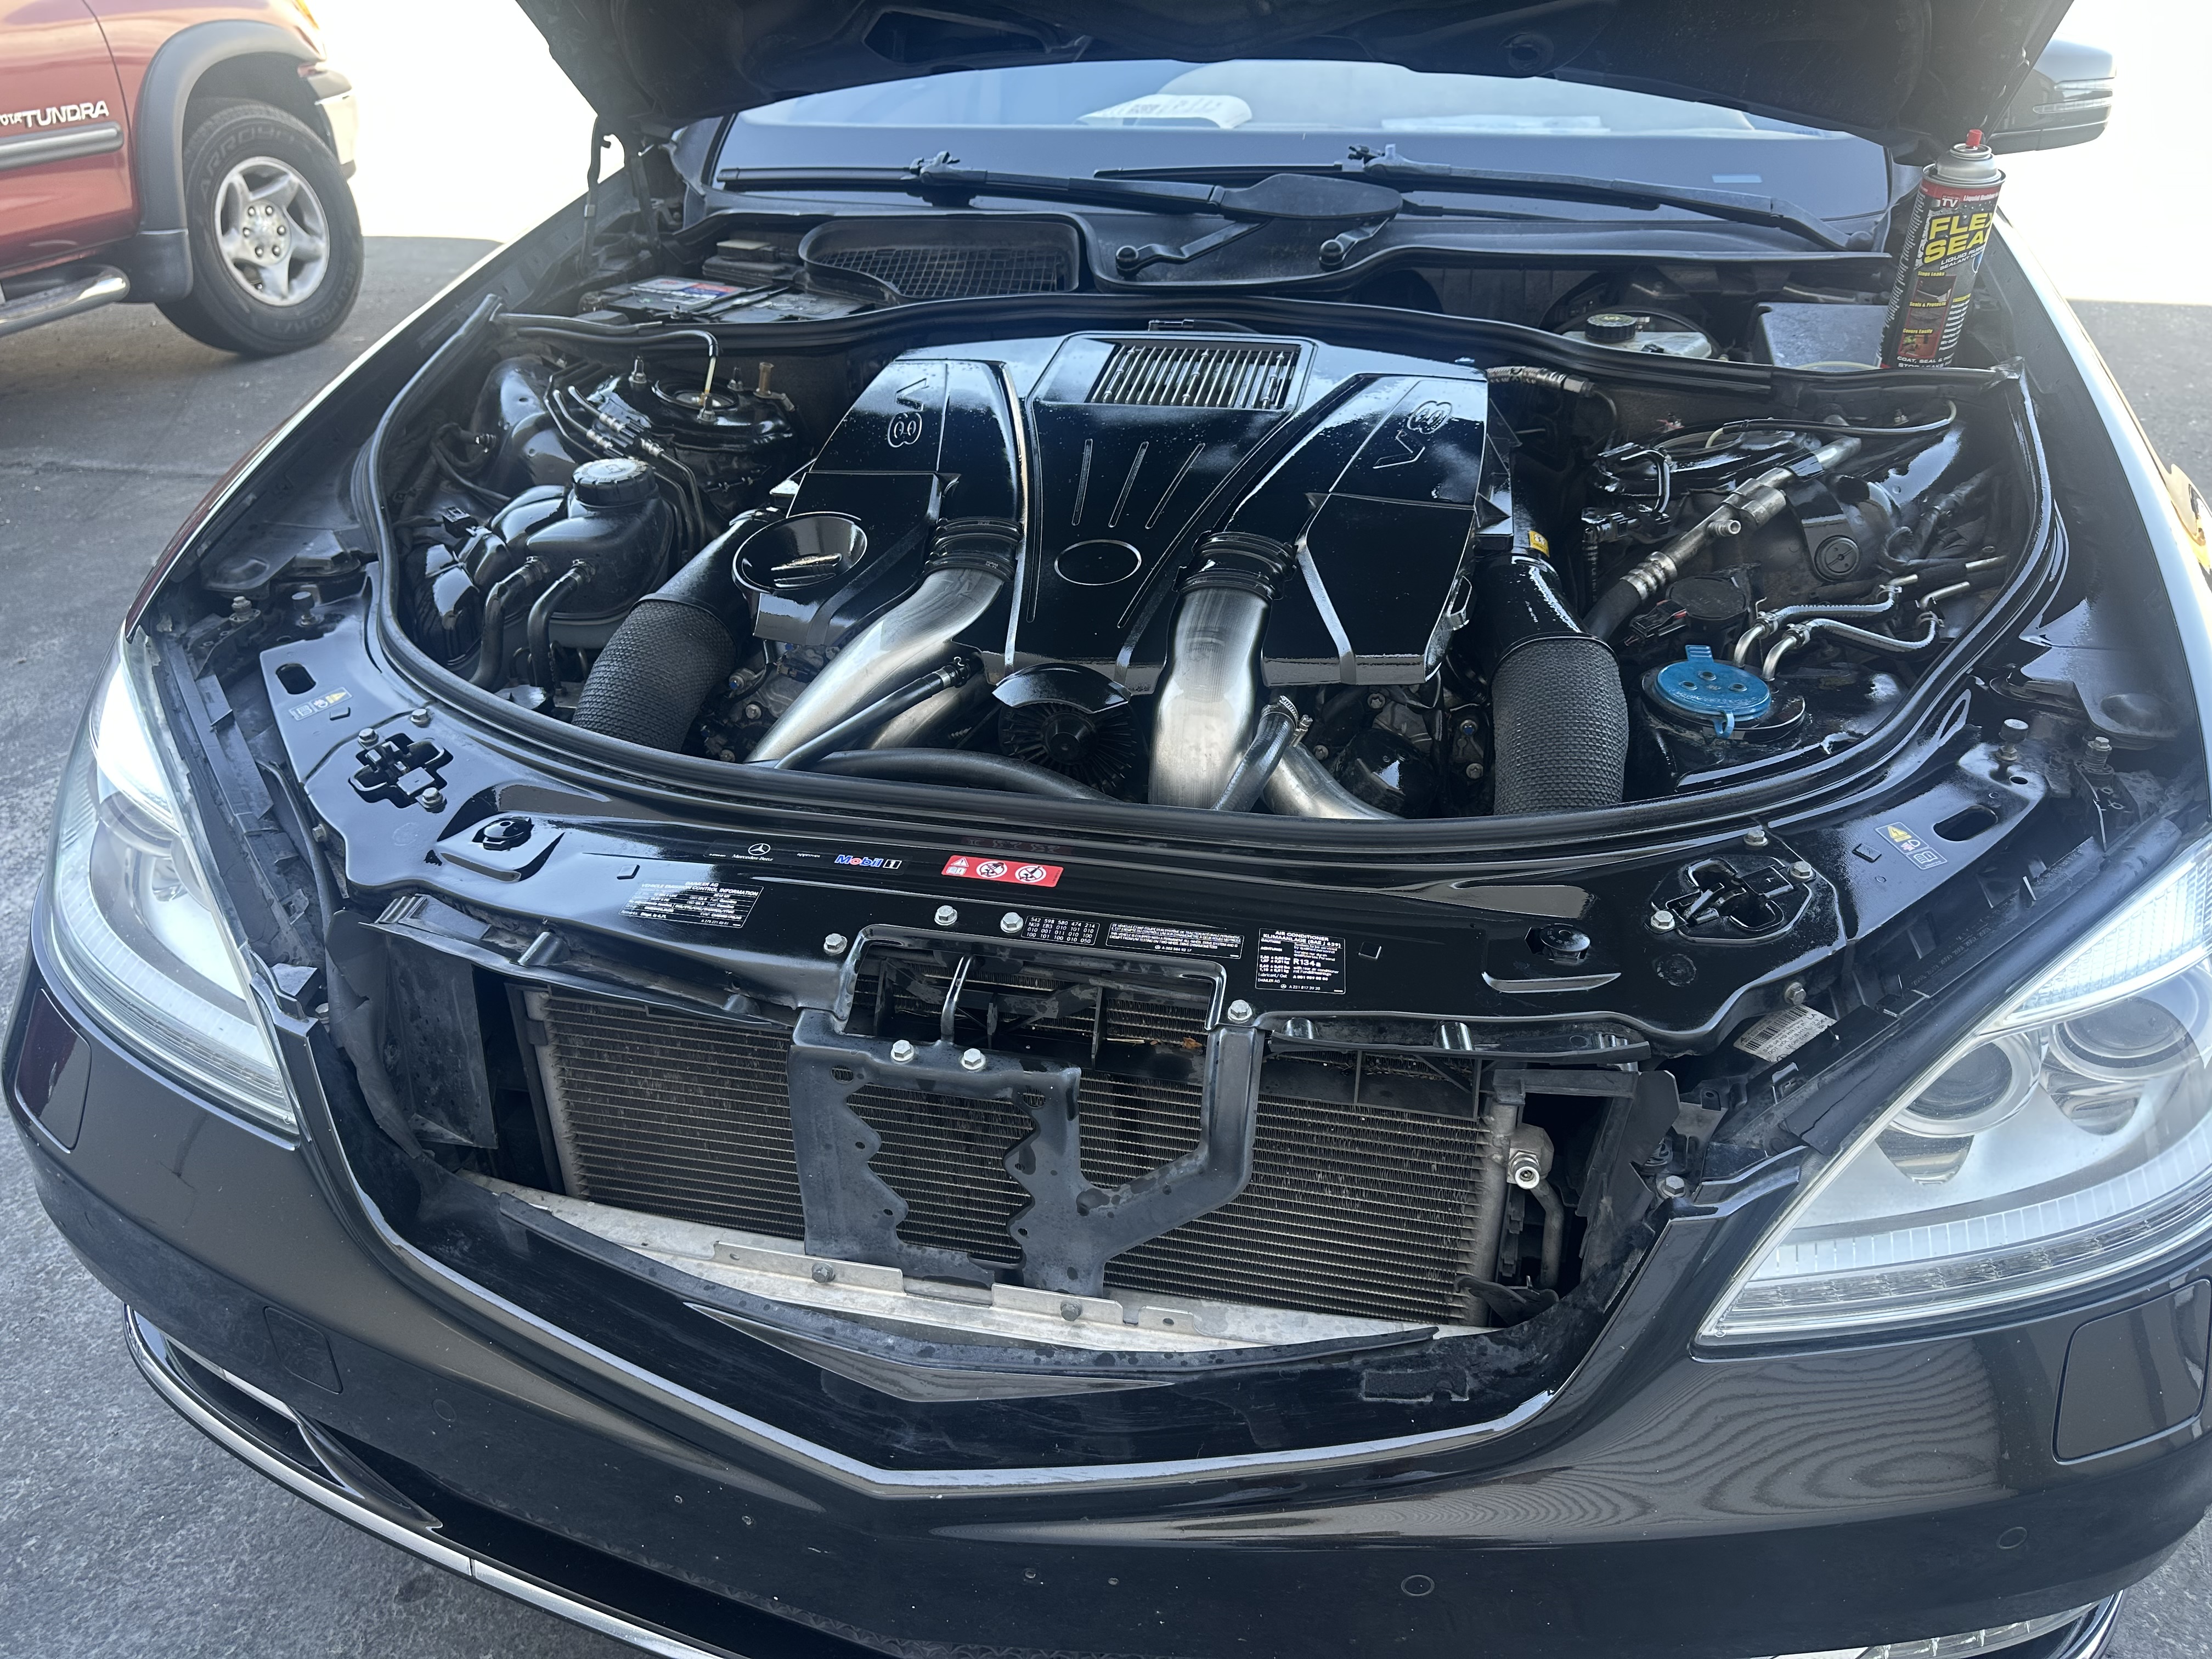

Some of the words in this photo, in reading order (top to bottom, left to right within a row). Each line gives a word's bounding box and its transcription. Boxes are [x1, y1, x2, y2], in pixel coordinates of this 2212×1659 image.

[0, 112, 22, 126] OTA
[22, 100, 109, 127] TUNDRA
[1942, 198, 1958, 207] TV
[1940, 256, 1970, 270] SEALANT
[1941, 252, 1967, 265] LIQUID
[887, 377, 929, 449] V8
[1373, 400, 1453, 470] V8
[834, 854, 884, 867] Mobil
[1263, 933, 1306, 943] KLIMAANLAGE
[1286, 933, 1328, 941] CONDITIONER
[1293, 958, 1321, 967] R134a
